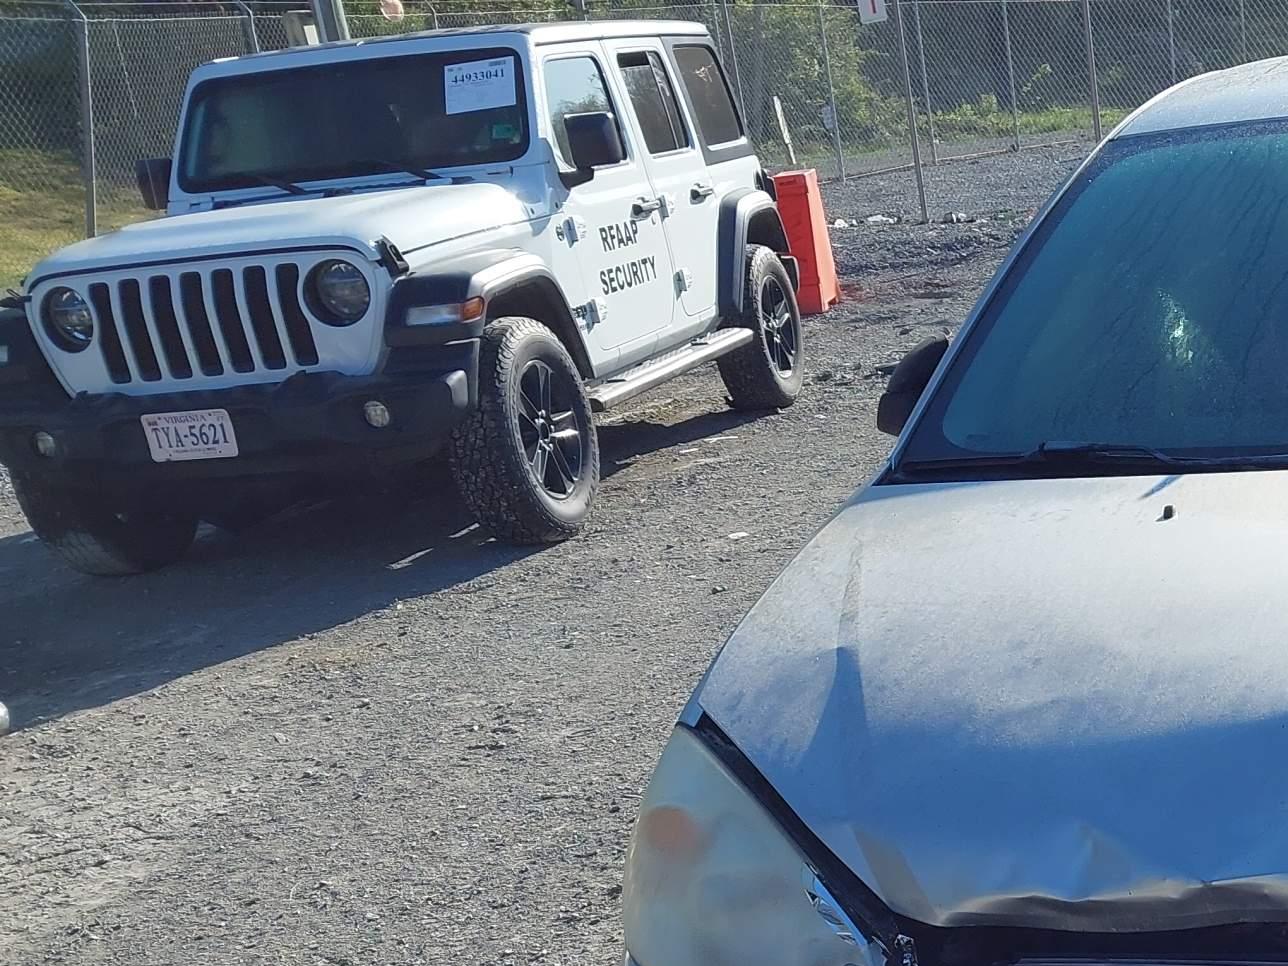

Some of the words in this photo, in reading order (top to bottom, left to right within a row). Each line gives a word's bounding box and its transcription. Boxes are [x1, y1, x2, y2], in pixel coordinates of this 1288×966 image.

[451, 68, 504, 84] 44933041
[599, 219, 639, 252] RFAAP
[600, 255, 657, 295] SECURITY
[163, 414, 207, 424] VIRGINIA
[151, 422, 230, 449] TYA-5621
